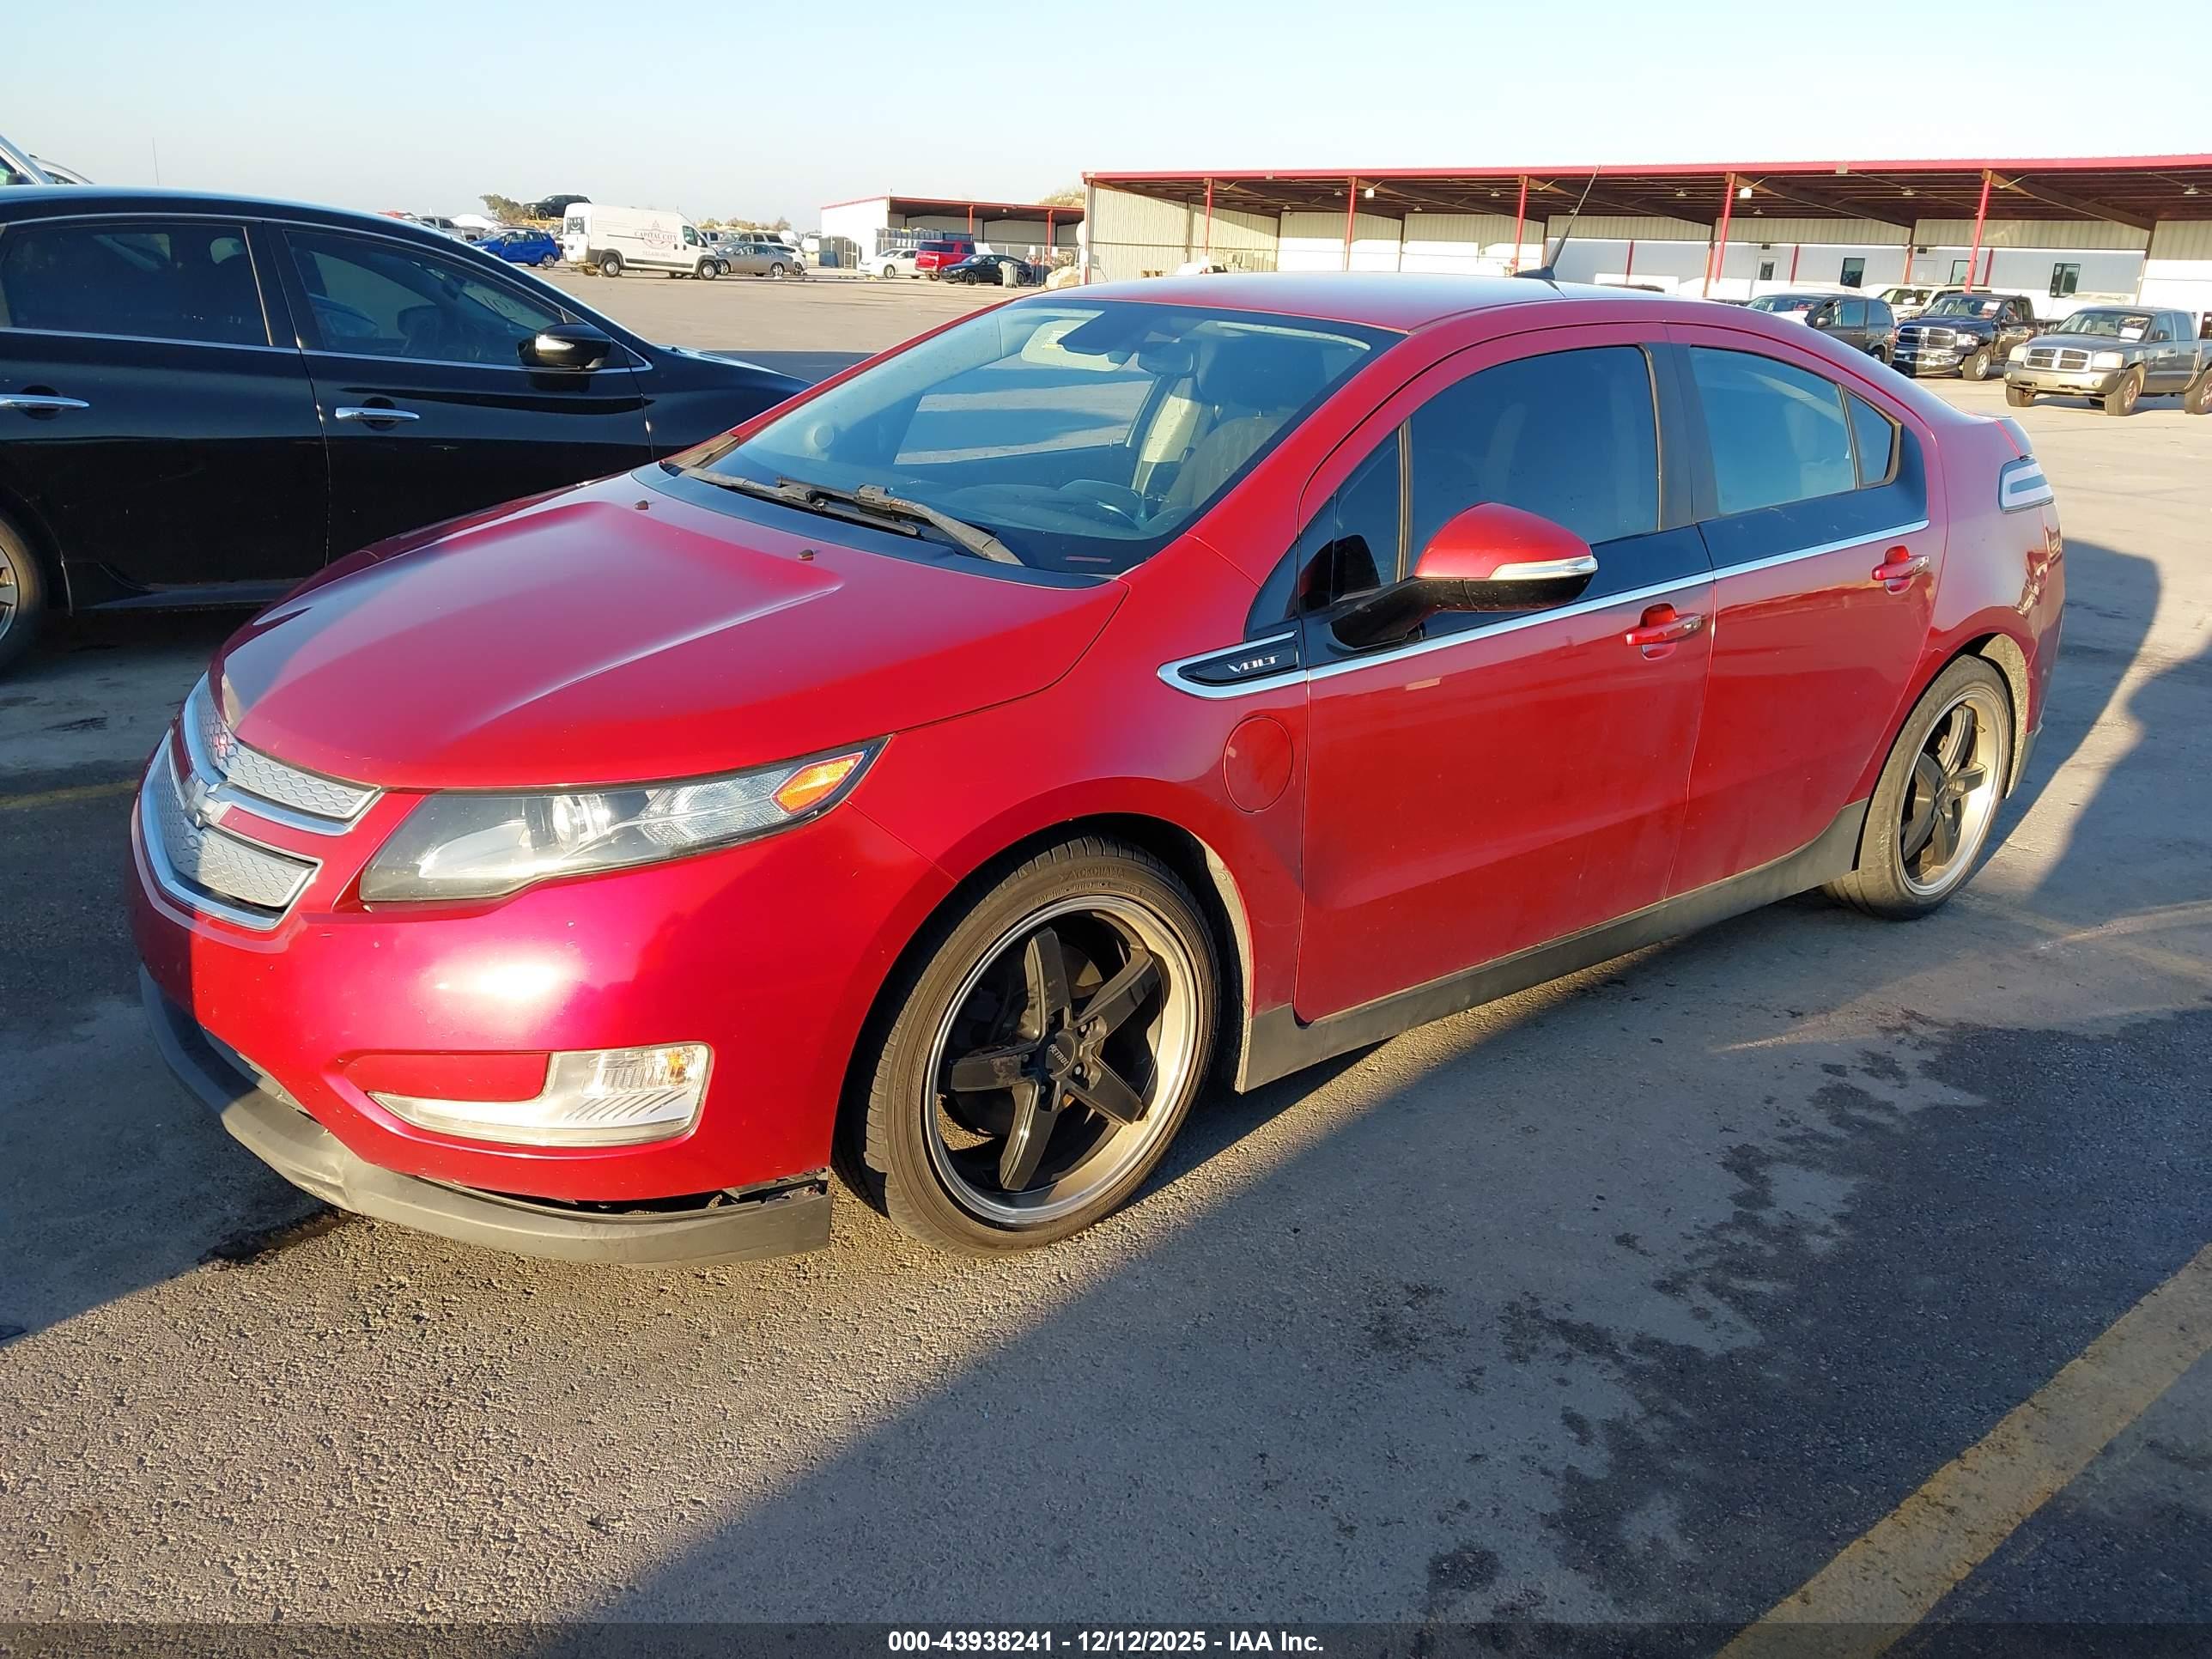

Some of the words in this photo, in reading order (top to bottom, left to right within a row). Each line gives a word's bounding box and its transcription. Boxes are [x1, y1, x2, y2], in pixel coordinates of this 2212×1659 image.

[634, 231, 660, 240] CAPITAL
[1227, 655, 1280, 674] VOLT
[1049, 1043, 1070, 1066] PETROL
